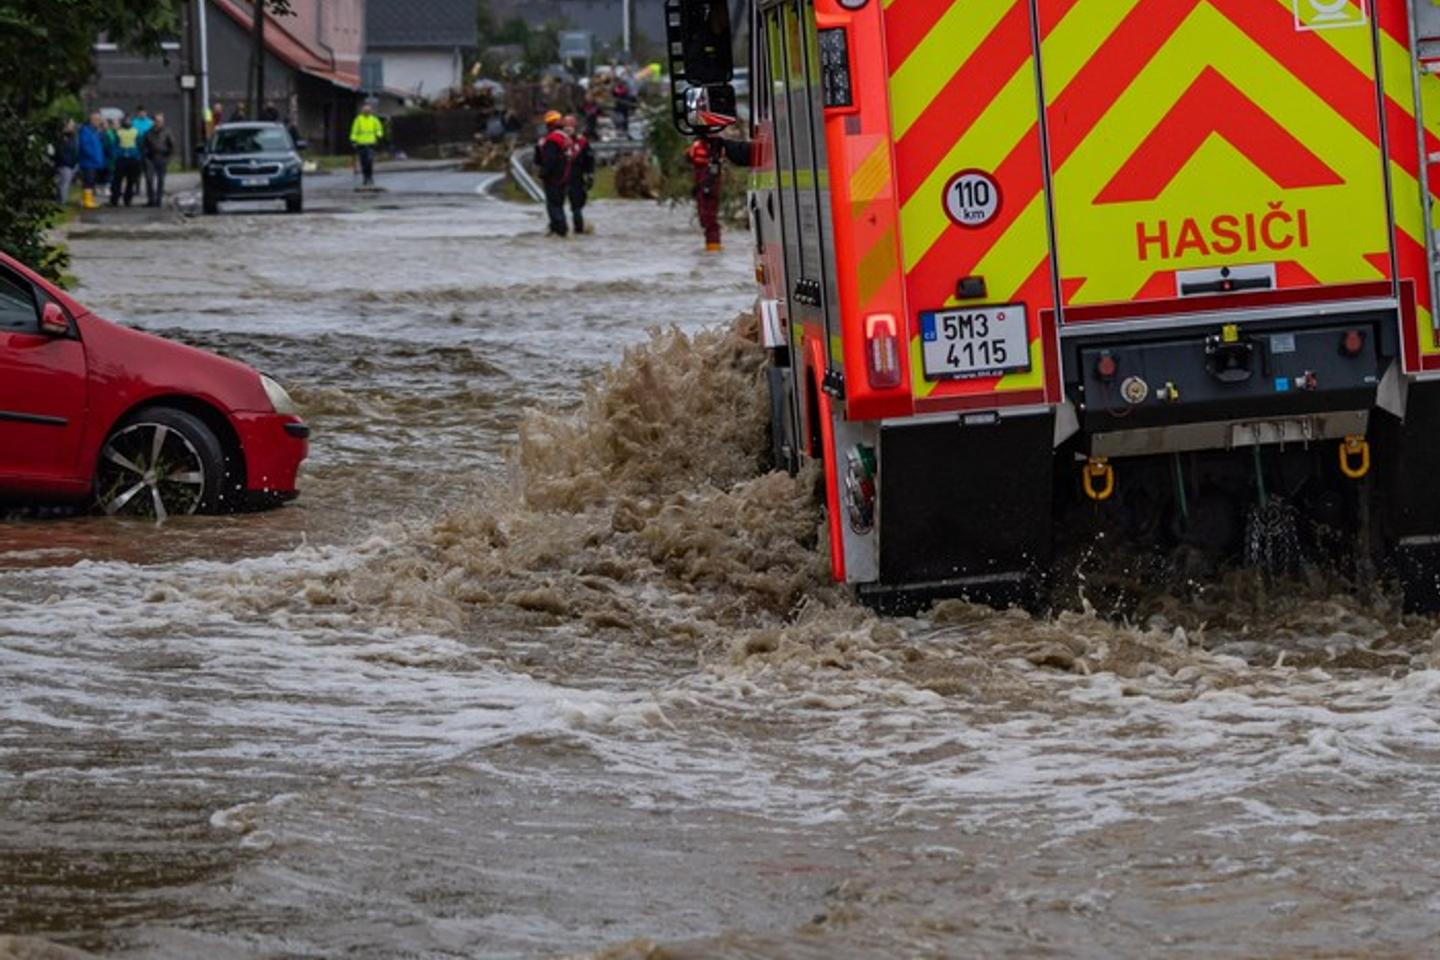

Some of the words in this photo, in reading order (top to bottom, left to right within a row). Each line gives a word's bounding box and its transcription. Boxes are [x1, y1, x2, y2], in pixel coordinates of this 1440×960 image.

[954, 180, 990, 208] 110
[963, 208, 986, 220] km
[1136, 200, 1309, 261] HASIČI
[943, 313, 990, 340] 5M3
[946, 338, 1008, 369] 4115
